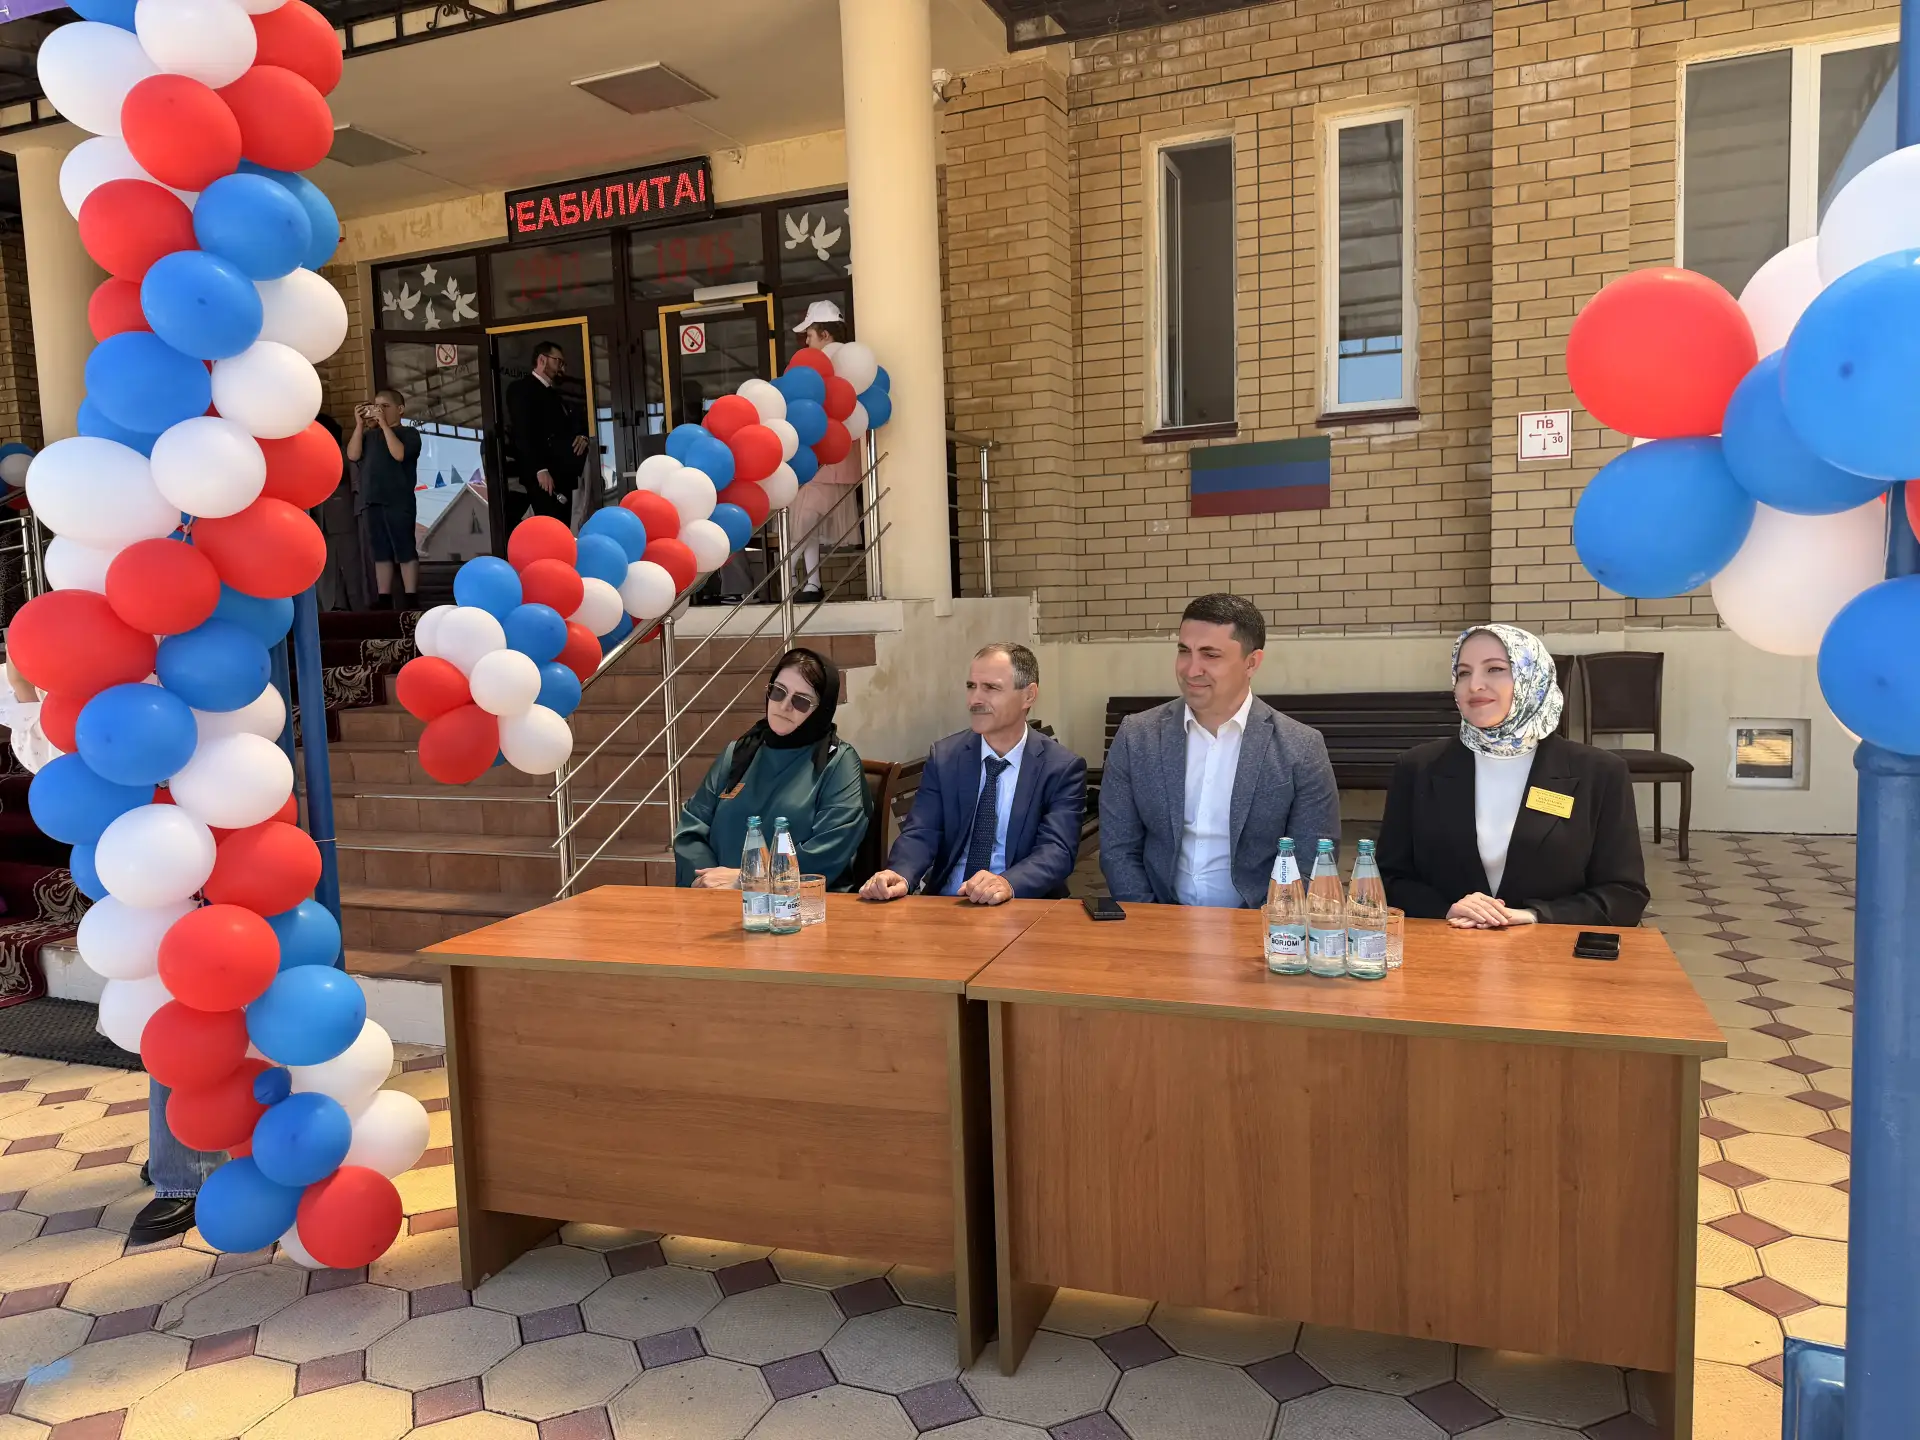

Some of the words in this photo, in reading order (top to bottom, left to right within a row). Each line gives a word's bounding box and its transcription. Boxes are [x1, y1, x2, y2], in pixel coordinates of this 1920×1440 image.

[509, 169, 706, 233] ЕАБИЛИТА
[1536, 419, 1554, 430] ПВ
[1552, 435, 1563, 444] 30
[1271, 937, 1300, 947] BORJOMI
